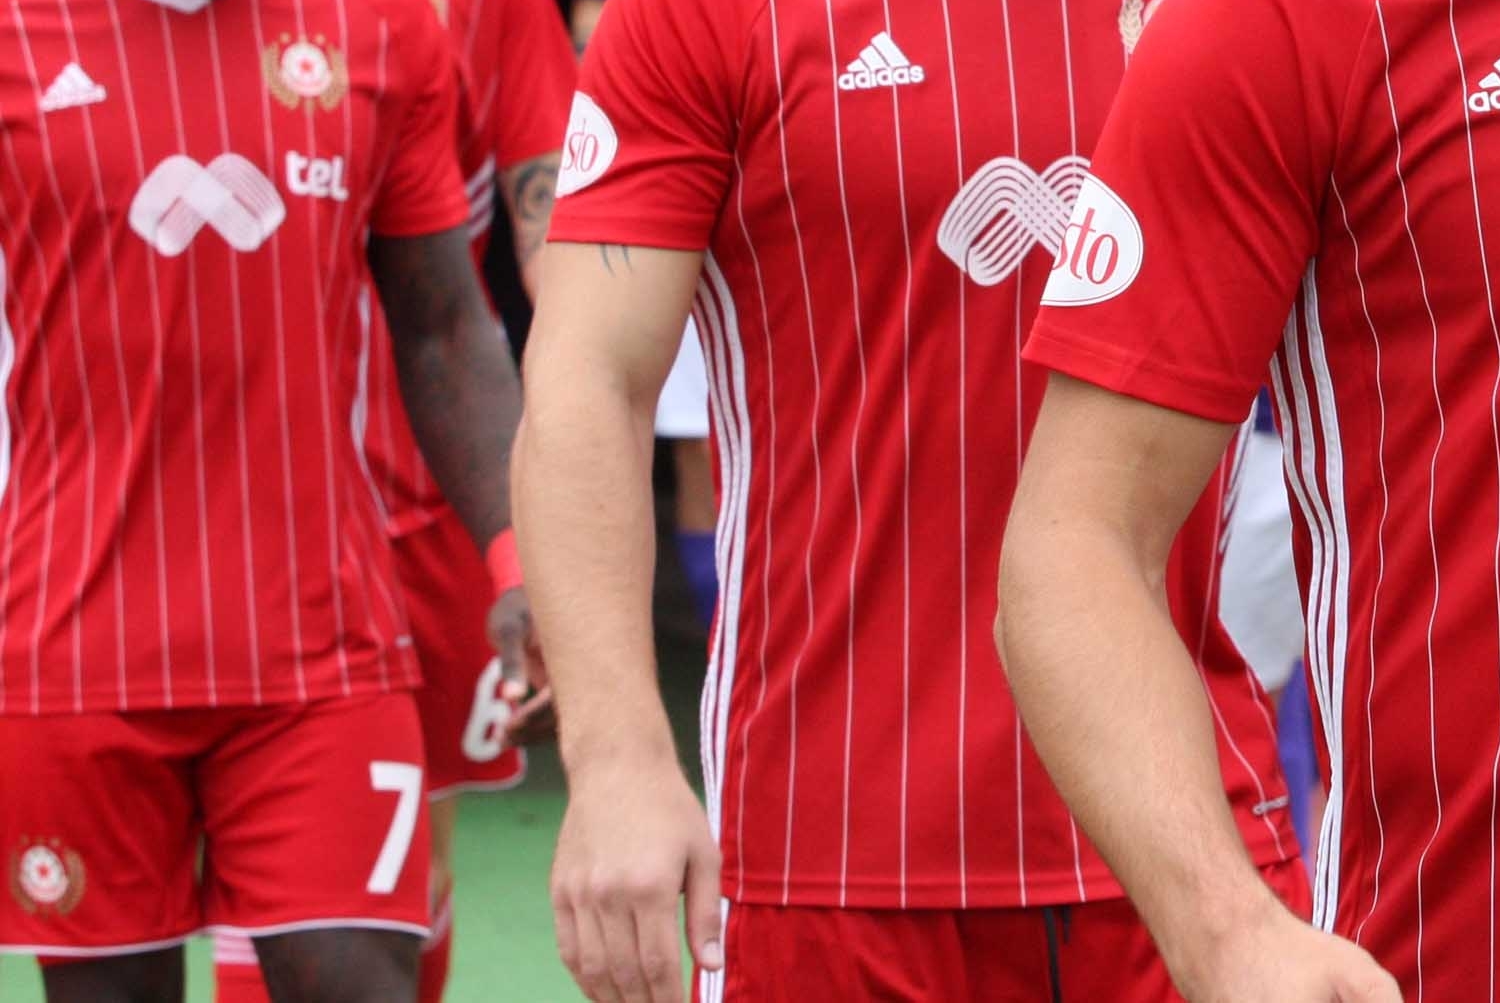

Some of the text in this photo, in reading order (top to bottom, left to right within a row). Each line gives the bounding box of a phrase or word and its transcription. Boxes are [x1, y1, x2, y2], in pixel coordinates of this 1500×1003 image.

[838, 64, 925, 91] adidas
[284, 150, 349, 203] tel
[366, 760, 424, 895] 7
